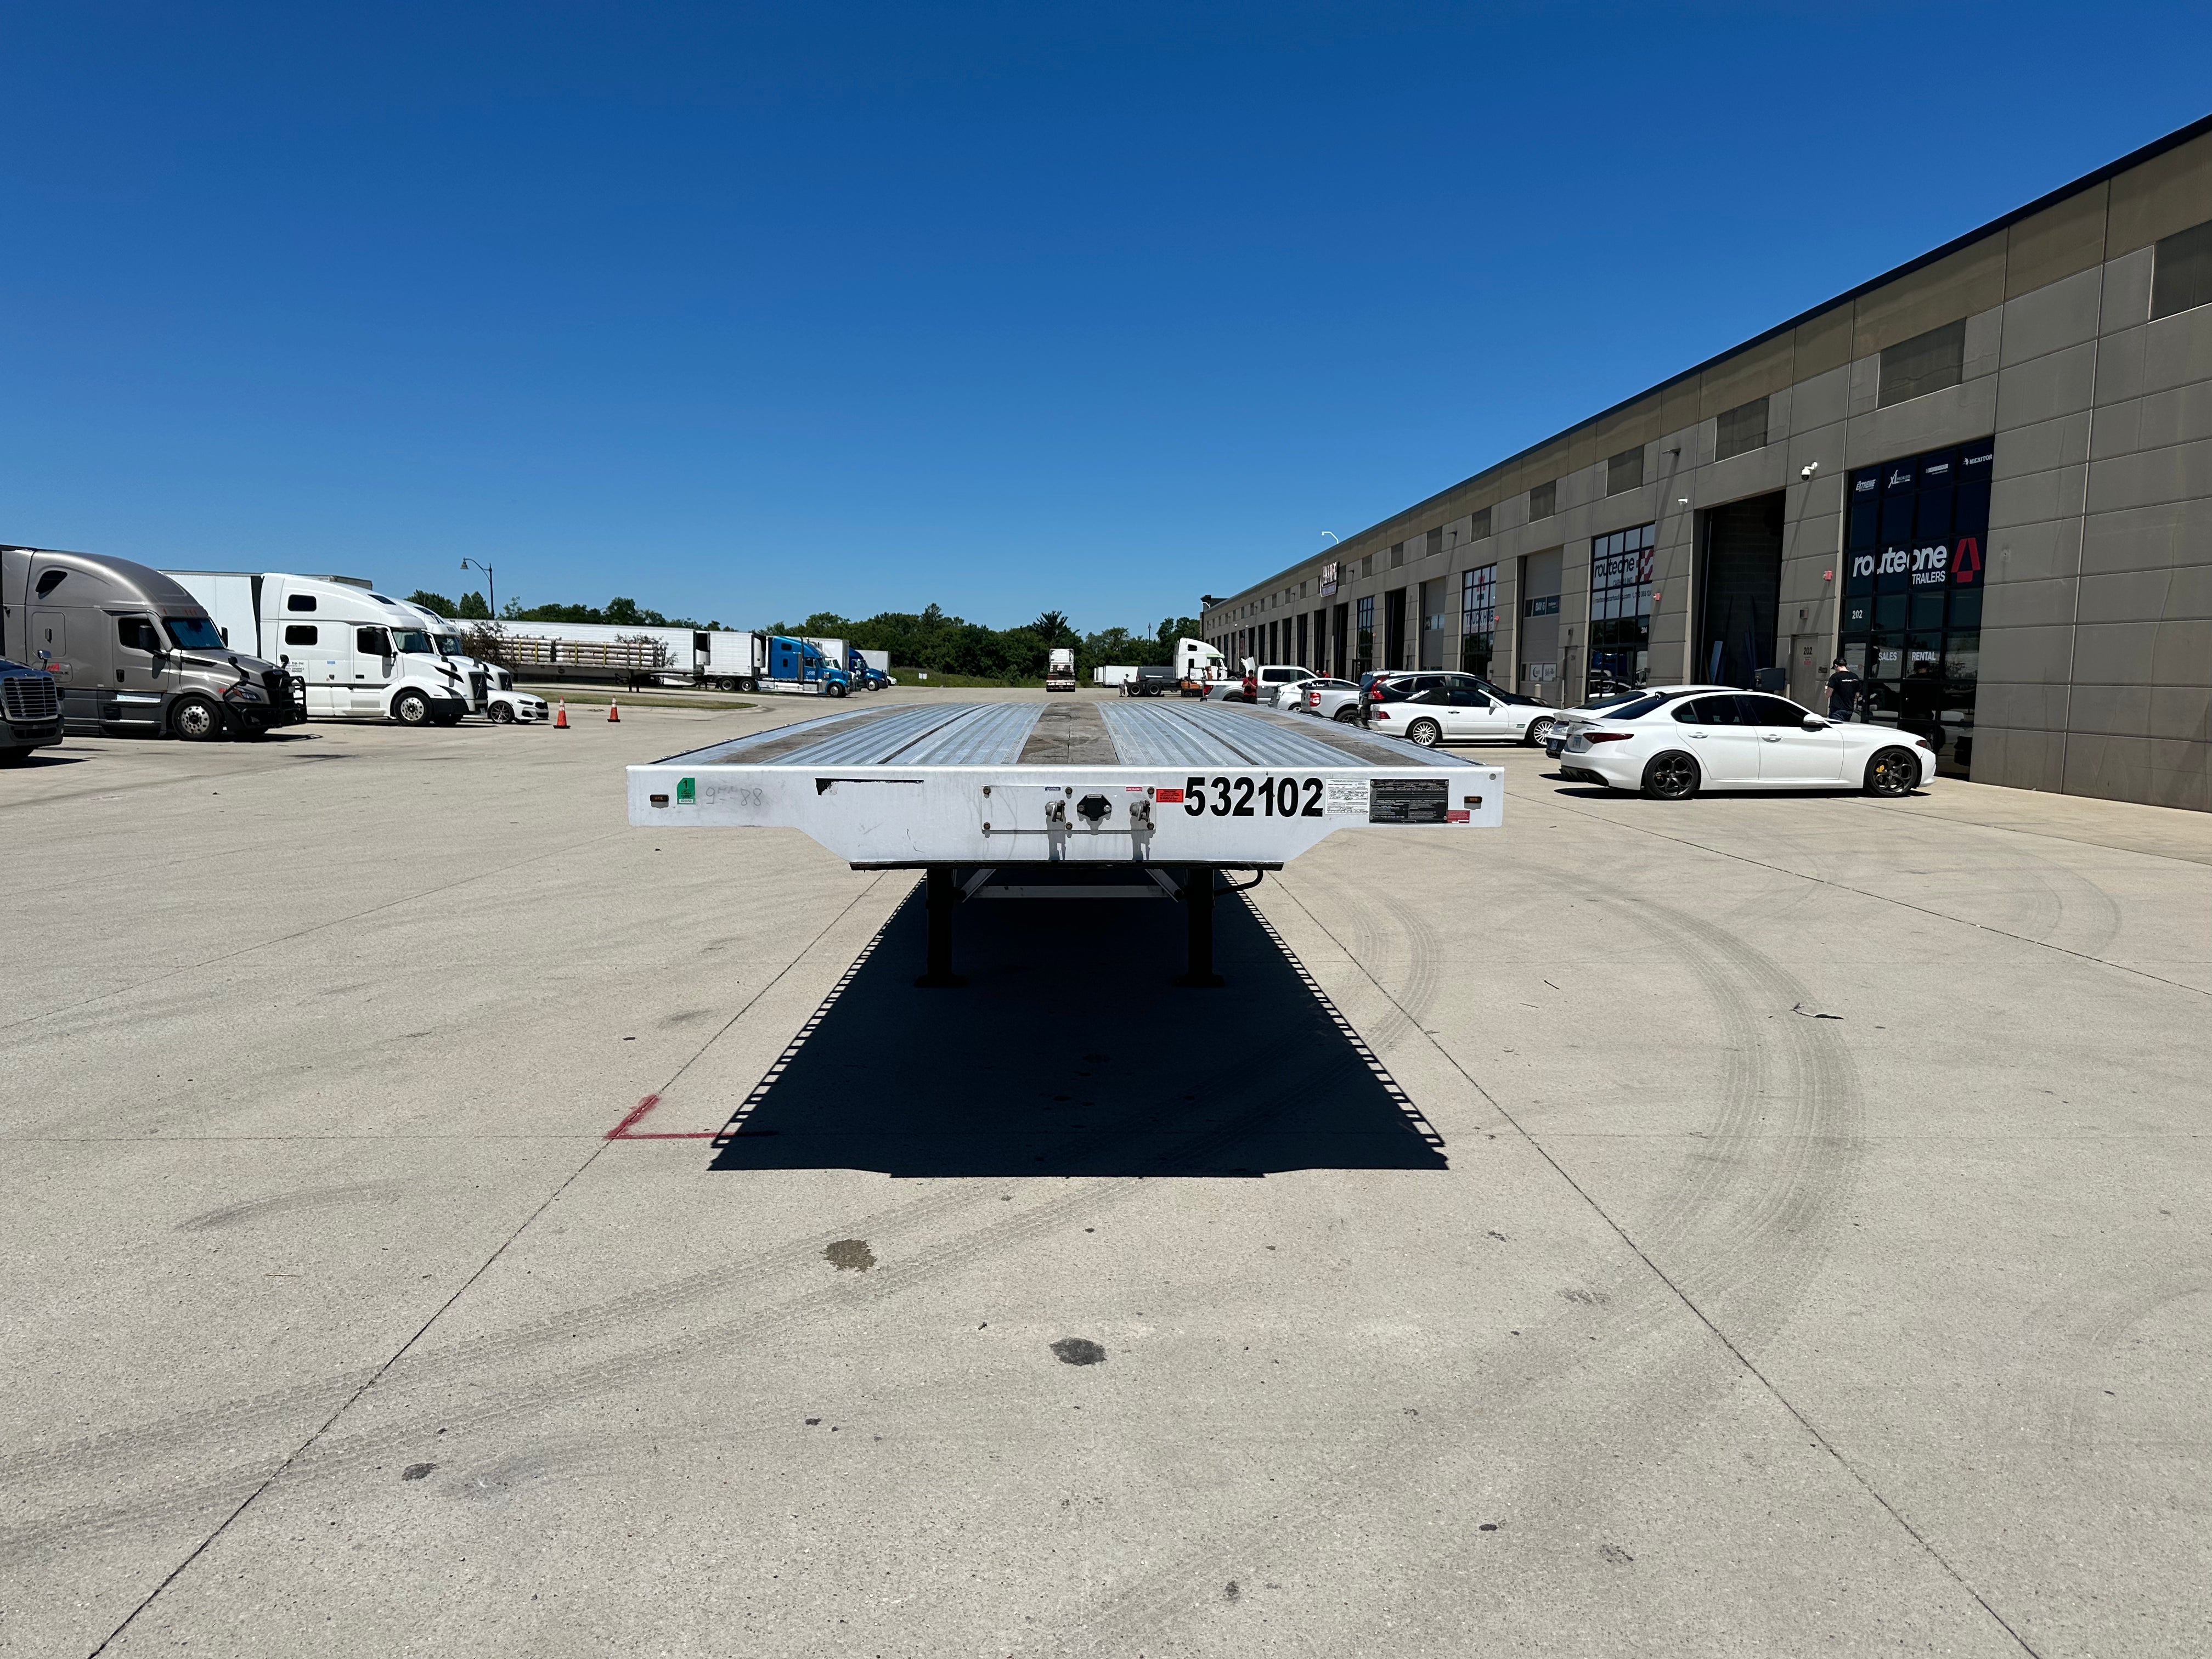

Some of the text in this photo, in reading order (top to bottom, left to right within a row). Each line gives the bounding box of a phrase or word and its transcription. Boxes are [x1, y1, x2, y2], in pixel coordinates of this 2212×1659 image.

[1970, 454, 1993, 465] MERITOR
[1855, 478, 1876, 492] EXTREME
[1853, 545, 1947, 578] routeone
[1912, 571, 1945, 585] TRAILERS
[1466, 610, 1494, 625] TUCK HB
[1852, 610, 1863, 619] 202
[1803, 647, 1813, 655] 202
[1878, 652, 1898, 661] SALES
[1911, 651, 1936, 661] RENTAL
[683, 780, 688, 788] 1
[1184, 777, 1323, 817] 532102
